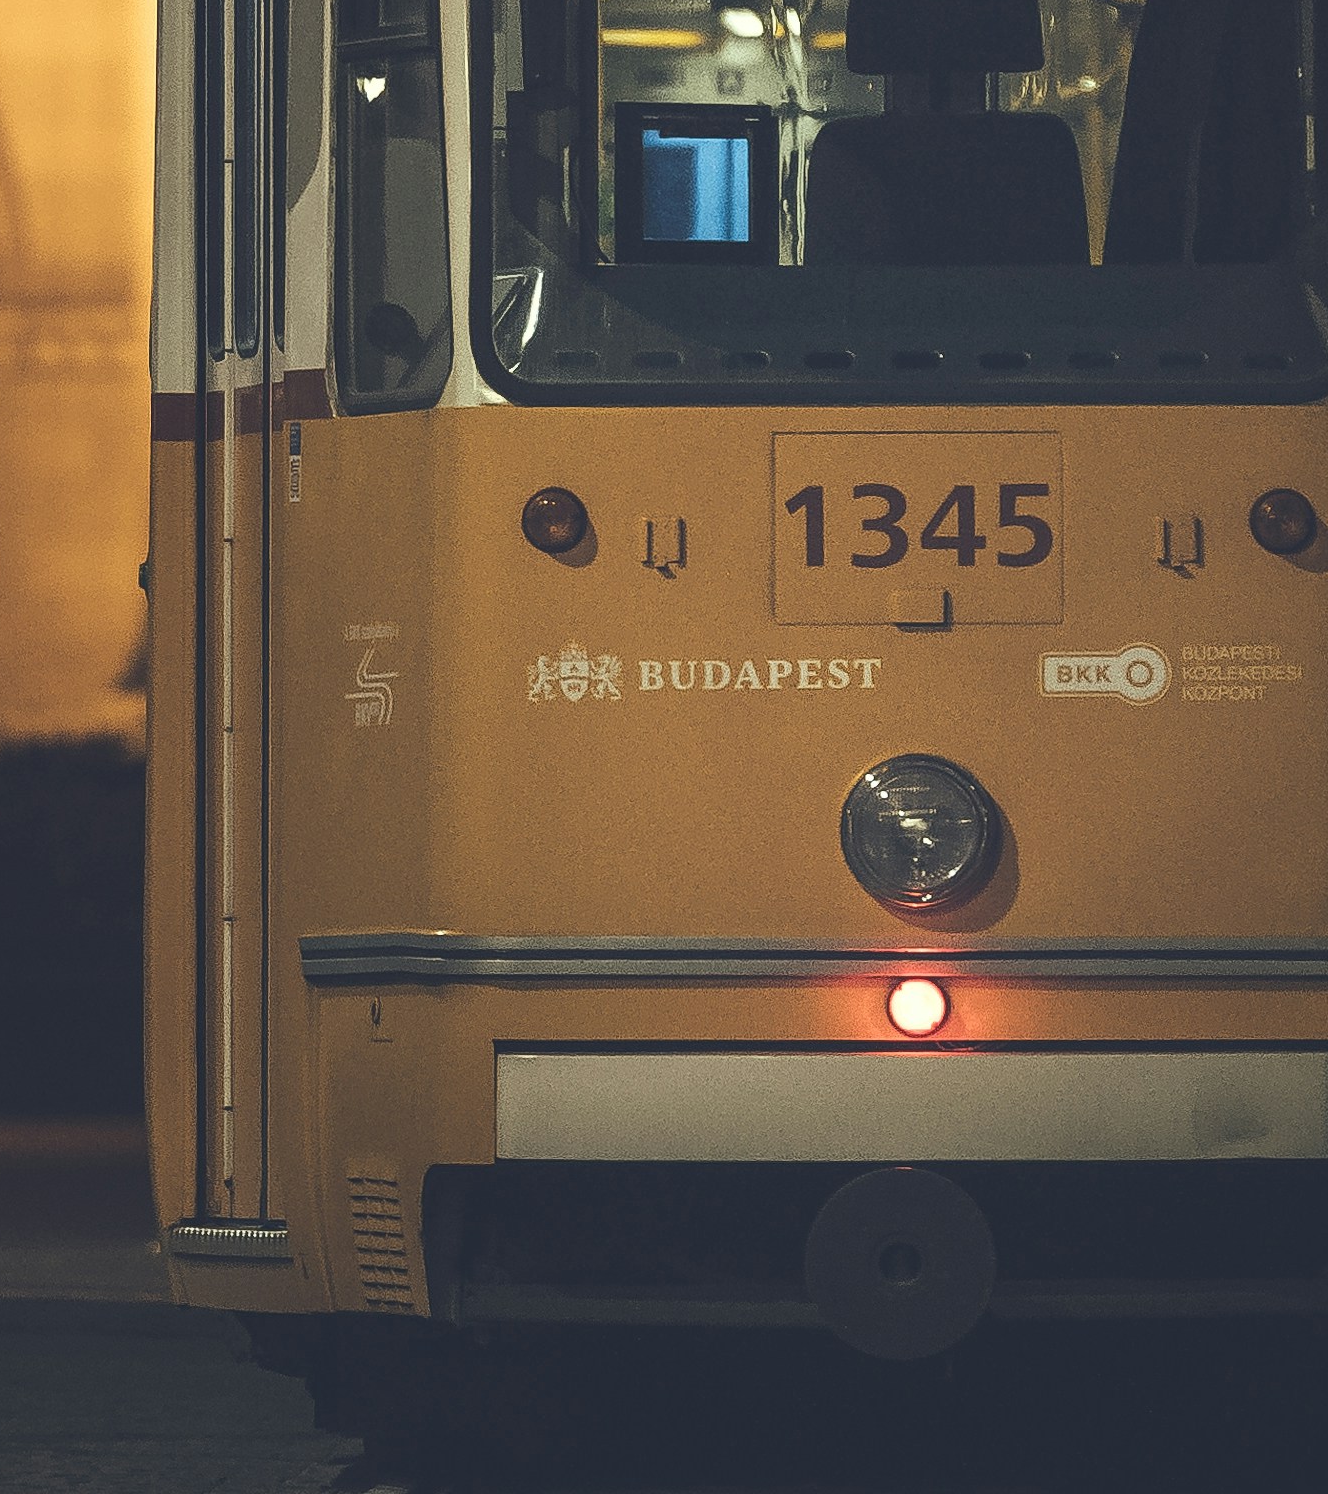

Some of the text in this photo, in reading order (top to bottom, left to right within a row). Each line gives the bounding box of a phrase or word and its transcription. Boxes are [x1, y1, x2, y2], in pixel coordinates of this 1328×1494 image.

[785, 483, 1054, 568] 1345
[639, 658, 882, 691] BUDAPEST
[1057, 665, 1112, 683] BKK
